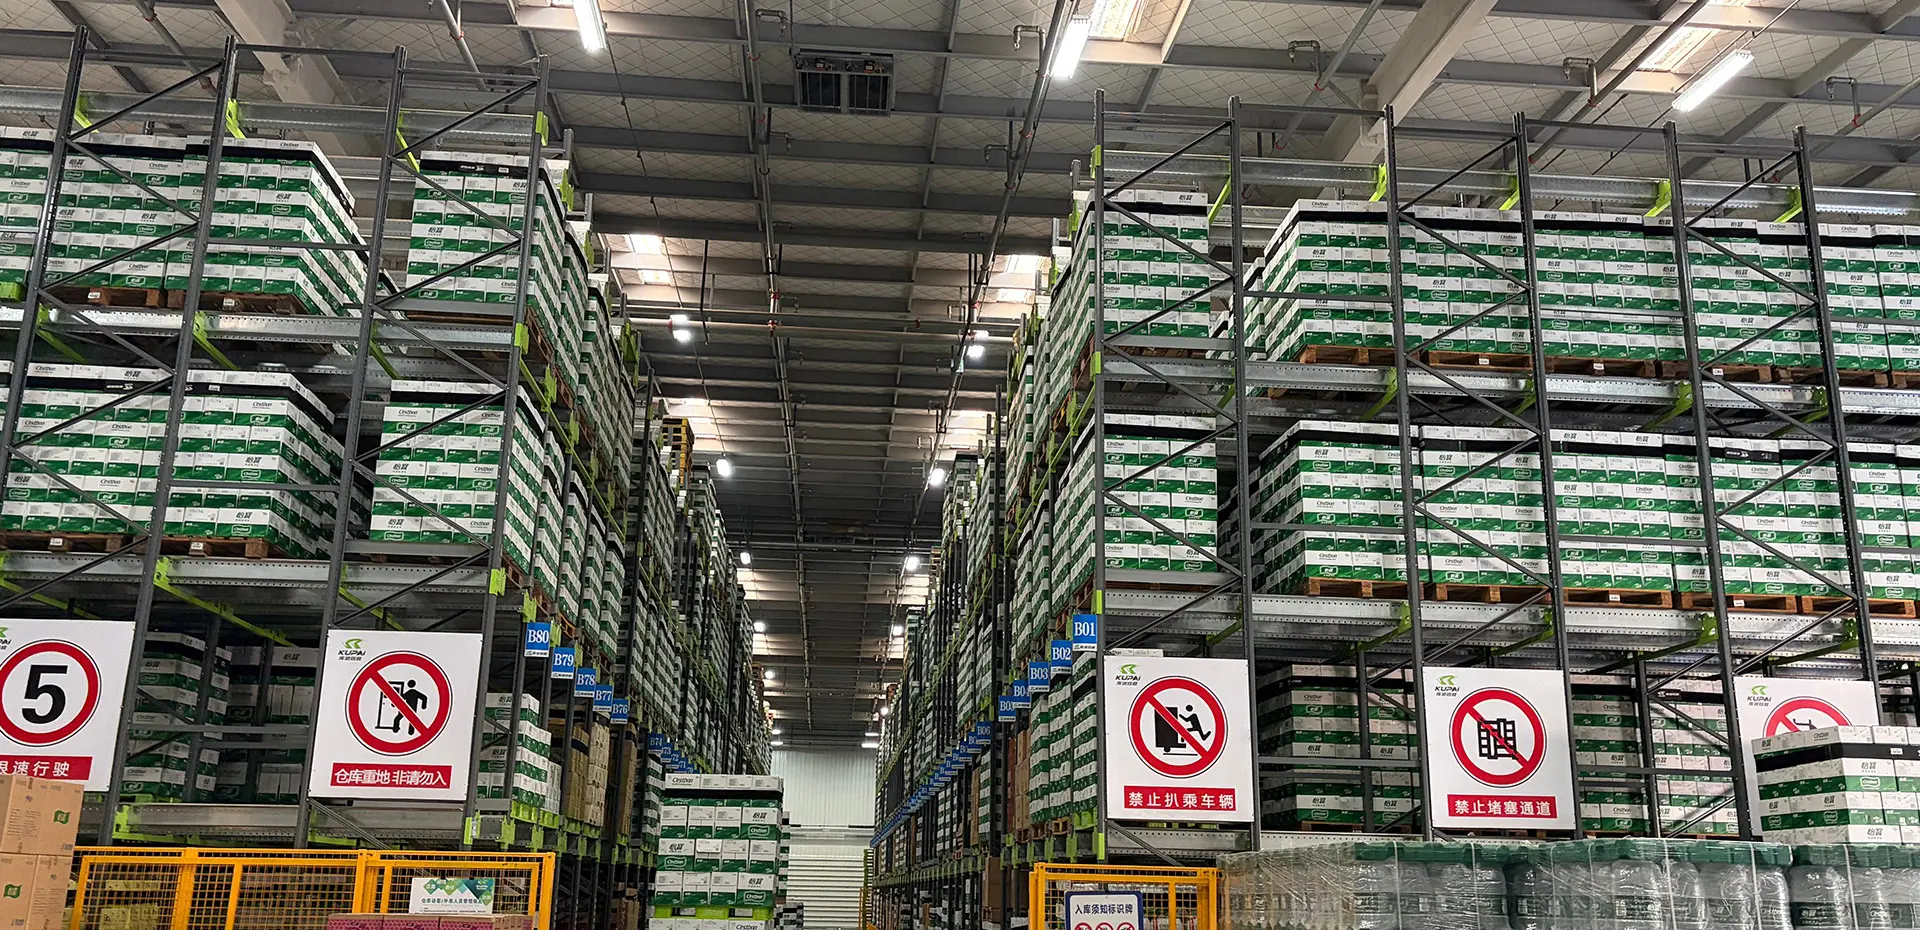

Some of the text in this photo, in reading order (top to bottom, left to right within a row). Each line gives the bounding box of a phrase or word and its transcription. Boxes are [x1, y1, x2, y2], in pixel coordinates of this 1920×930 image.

[1075, 622, 1095, 636] B01
[528, 630, 549, 643] B80
[1052, 647, 1071, 660] B02
[554, 654, 574, 666] B79
[1031, 668, 1048, 679] B03
[577, 674, 596, 686] B78
[22, 665, 68, 724] 5
[596, 690, 612, 701] B77
[613, 704, 628, 714] B76
[977, 726, 990, 735] B06
[335, 768, 446, 785] 仓库重地 非请勿入
[1129, 792, 1234, 808] 禁止扒乘车辆
[1455, 800, 1551, 815] 禁止堵塞通道
[1075, 904, 1133, 914] 入库须知标识牌
